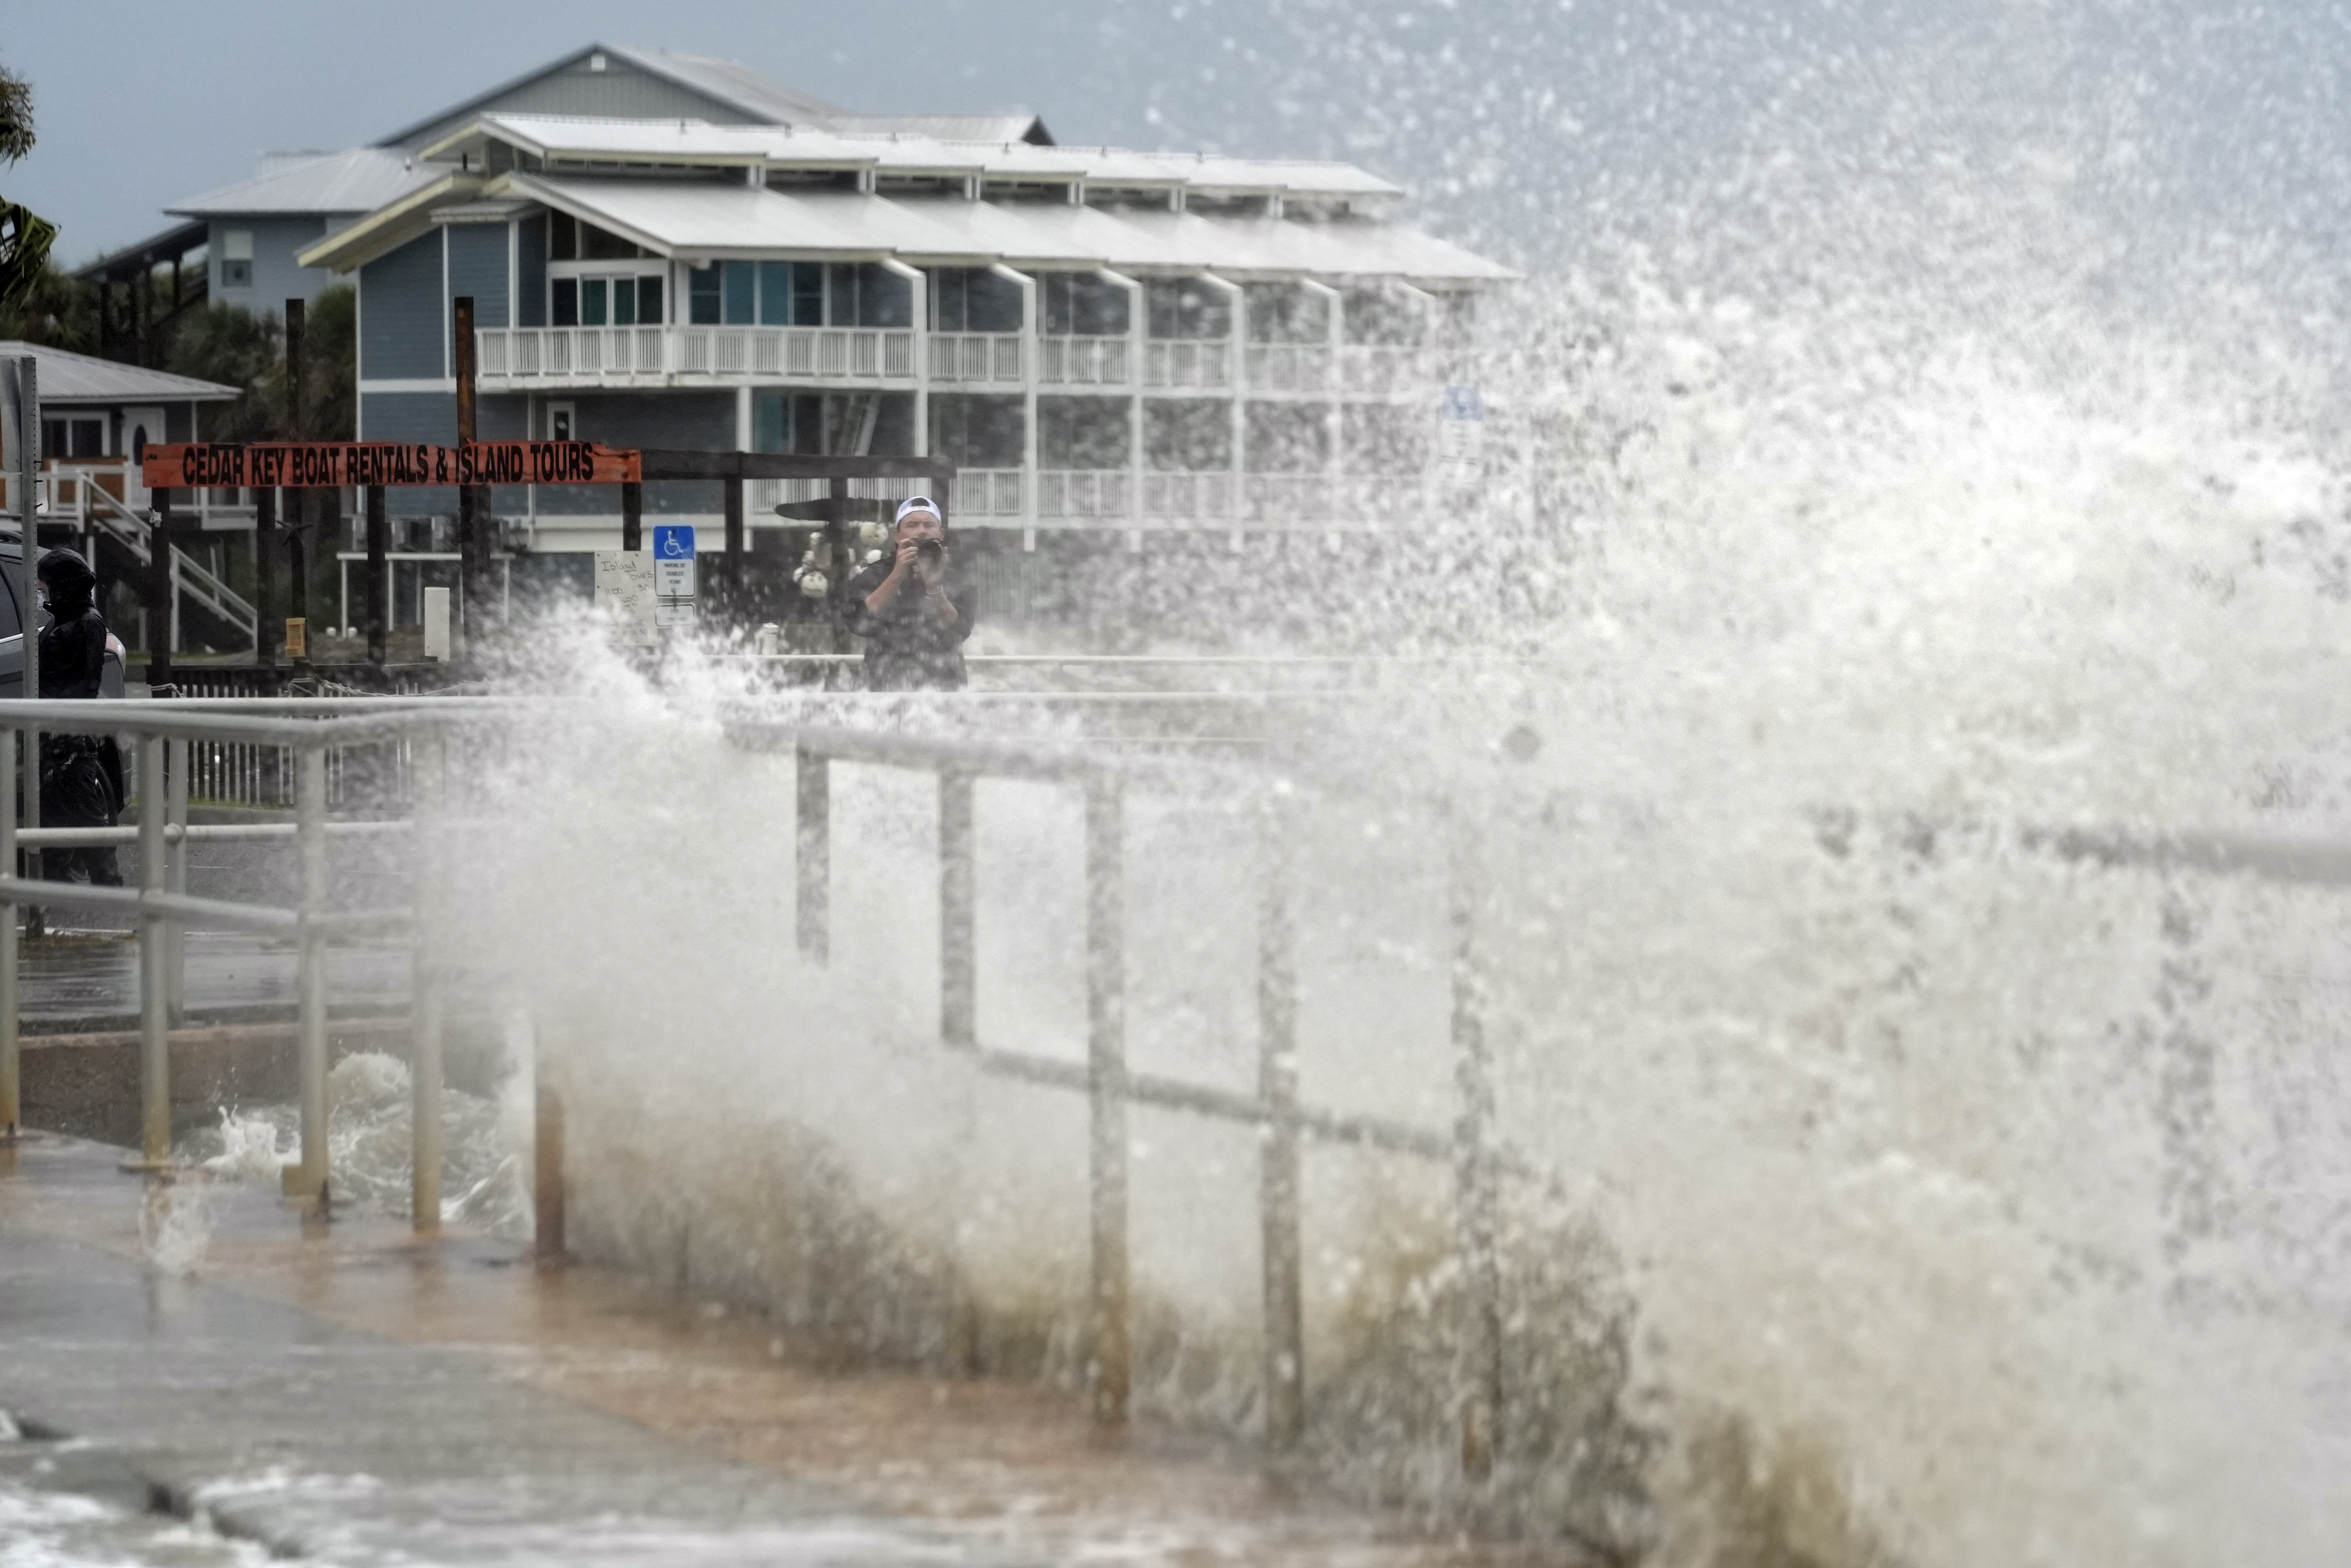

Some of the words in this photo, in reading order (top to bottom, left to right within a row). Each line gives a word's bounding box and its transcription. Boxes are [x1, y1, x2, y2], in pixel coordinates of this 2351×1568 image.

[182, 446, 244, 485] CEDAR
[251, 447, 286, 485] KEY
[292, 446, 339, 485] BOAT
[347, 445, 429, 484] RENTALS
[436, 447, 448, 483] &
[455, 445, 523, 483] ISLAND
[530, 442, 593, 484] TOURS
[601, 560, 637, 571] Island
